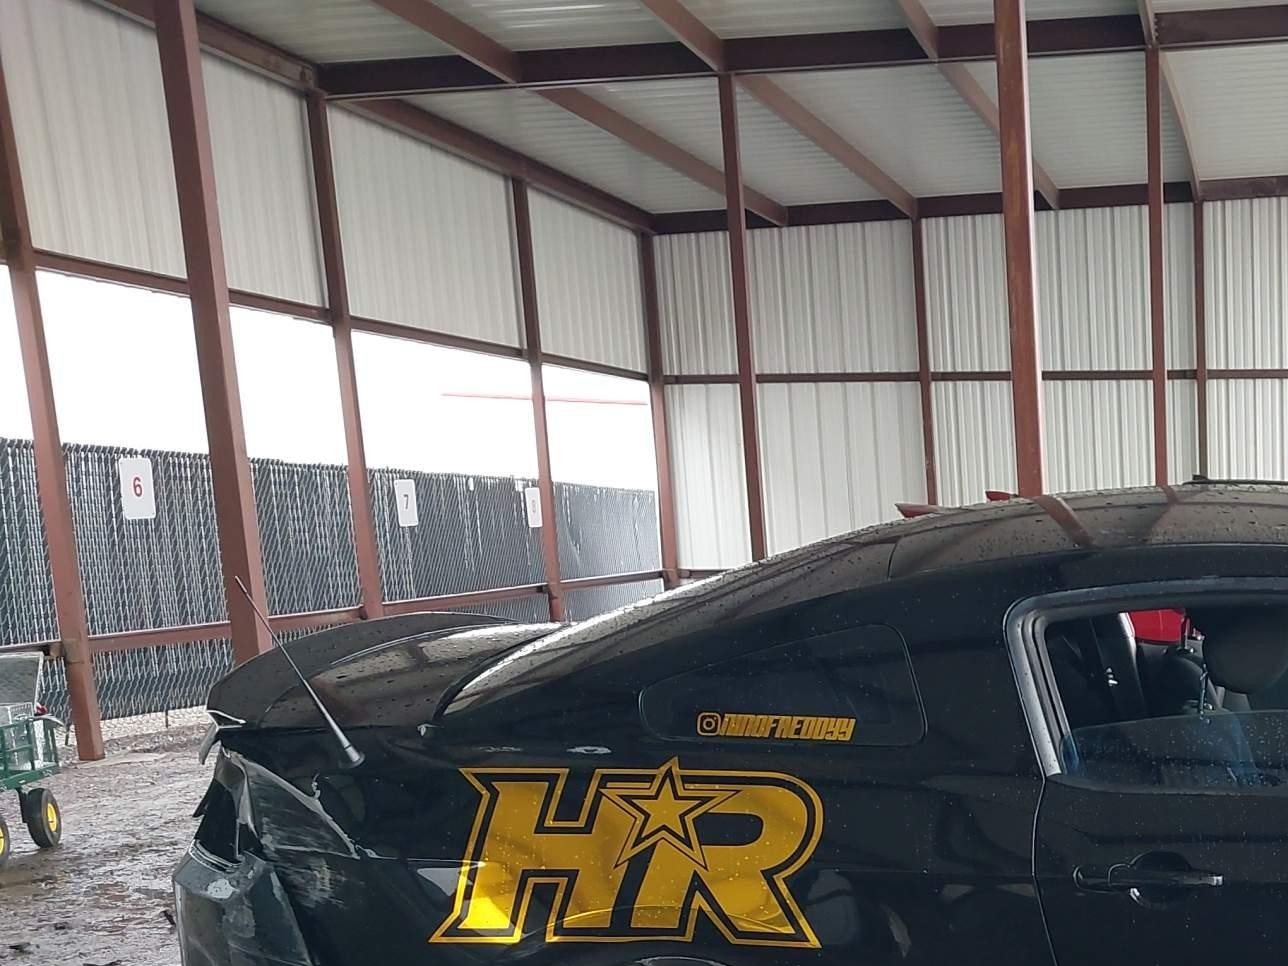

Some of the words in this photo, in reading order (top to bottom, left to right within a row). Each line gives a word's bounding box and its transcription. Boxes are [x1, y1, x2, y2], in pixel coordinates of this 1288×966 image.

[133, 476, 143, 497] 6
[403, 493, 410, 510] 7
[428, 766, 824, 949] HR
